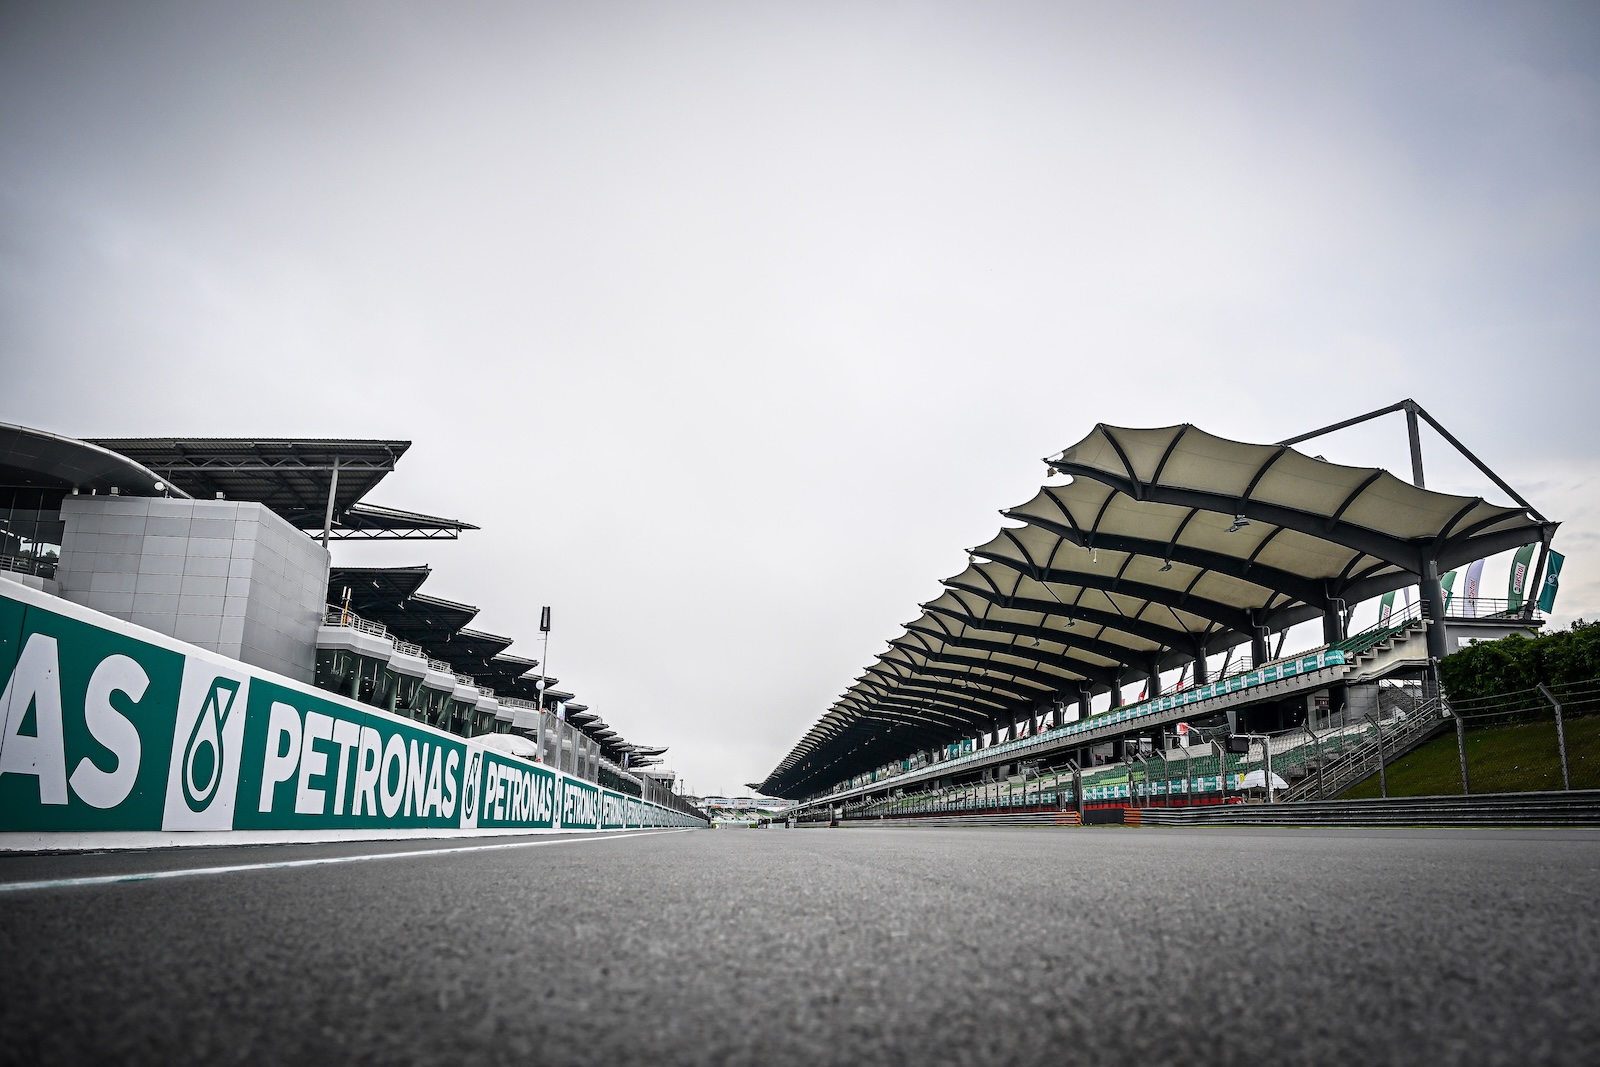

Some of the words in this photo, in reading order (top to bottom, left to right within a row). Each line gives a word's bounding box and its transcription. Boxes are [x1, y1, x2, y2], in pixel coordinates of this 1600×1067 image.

[259, 701, 459, 819] PETRONAS
[484, 761, 553, 822] PETRONAS
[563, 783, 598, 825] PETRONAS
